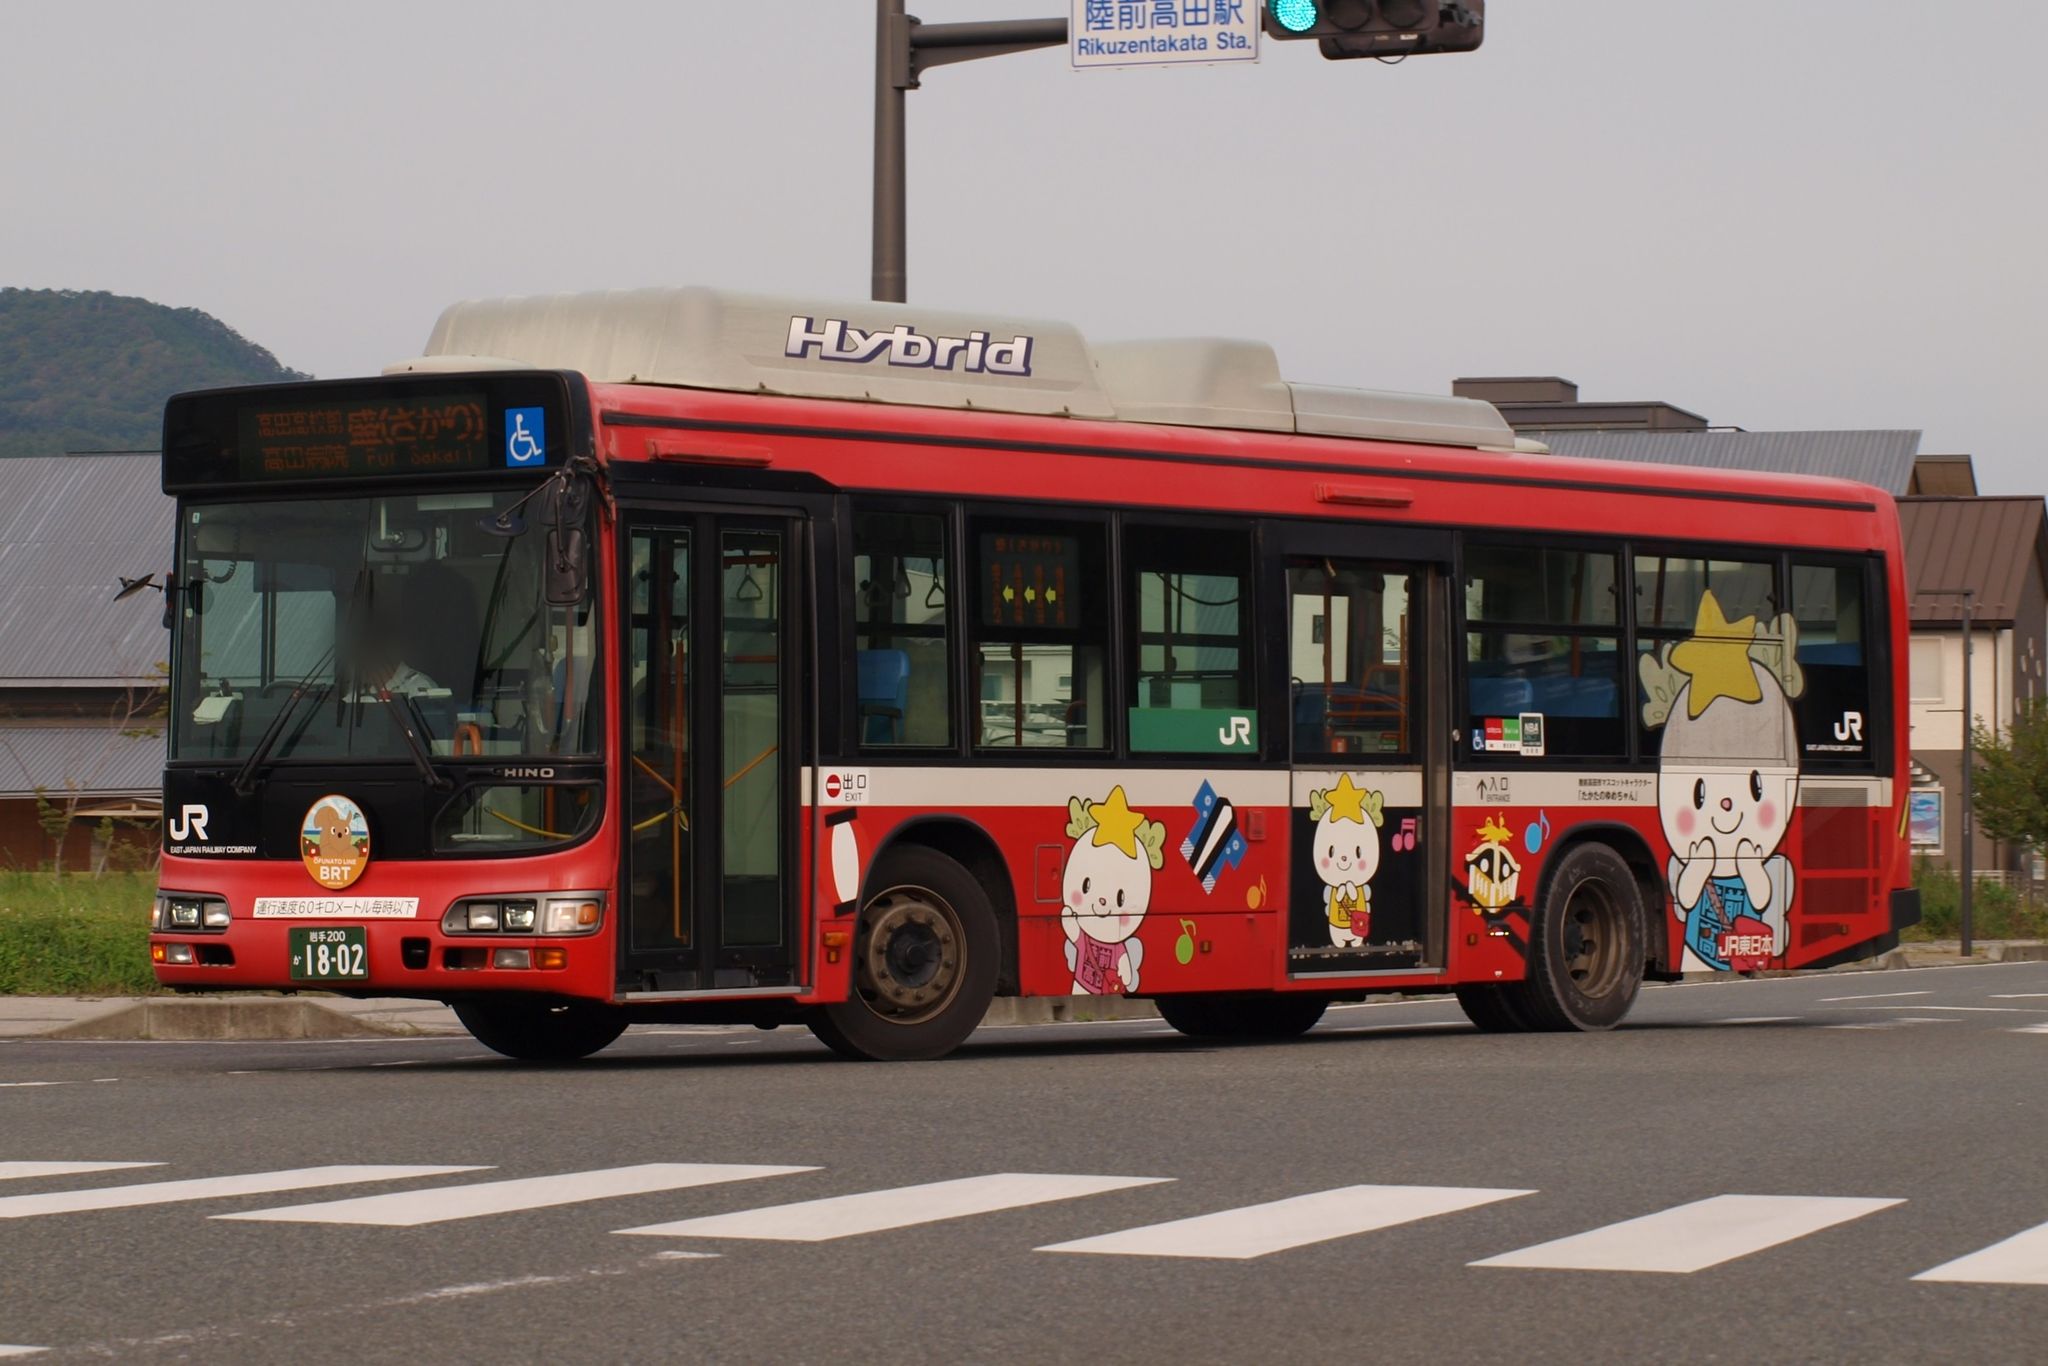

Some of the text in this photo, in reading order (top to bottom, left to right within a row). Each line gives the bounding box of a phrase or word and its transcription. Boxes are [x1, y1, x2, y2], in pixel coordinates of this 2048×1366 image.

[1085, 0, 1244, 32] 陸前高田駅
[1078, 31, 1252, 56] Rikuzentakata Sta.
[785, 315, 1034, 377] Hybrid
[1219, 716, 1250, 745] JR
[1834, 711, 1863, 741] JR
[504, 767, 555, 778] HINO
[843, 773, 867, 790] 出口
[1489, 776, 1508, 791] 入口
[845, 792, 863, 802] EXIT
[169, 804, 209, 841] JR
[170, 846, 183, 854] EAST
[183, 846, 201, 854] JAPAN
[226, 846, 257, 854] COMPANY
[320, 866, 351, 881] BRT
[256, 900, 415, 916] 運行速度60キロメートル毎時以下
[1718, 934, 1773, 956] JR東日本
[306, 944, 365, 976] 18-02
